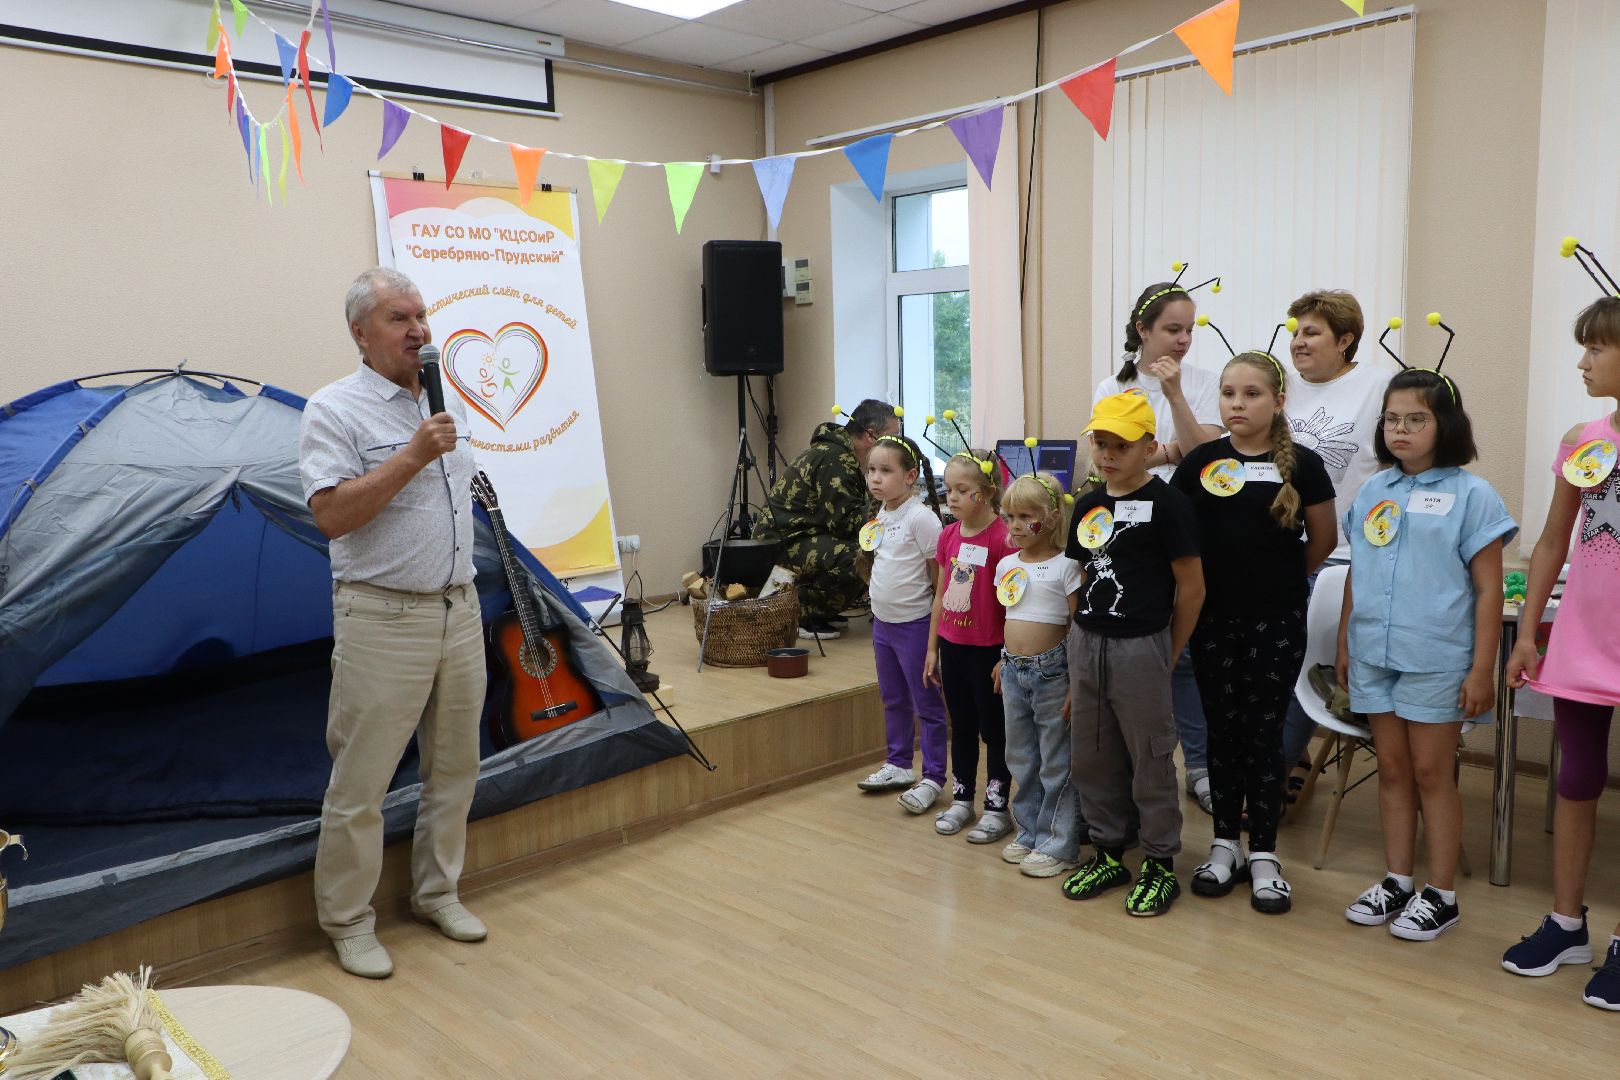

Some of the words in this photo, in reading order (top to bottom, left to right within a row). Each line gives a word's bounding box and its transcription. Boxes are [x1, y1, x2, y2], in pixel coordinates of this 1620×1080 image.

[411, 223, 440, 238] ГАУ
[444, 225, 465, 239] СО
[468, 226, 492, 240] МО
[494, 227, 555, 244] "КЦСОиР
[406, 244, 564, 265] "Серебряно-Прудский"
[426, 284, 490, 317] истический
[492, 285, 520, 298] слёт
[523, 293, 544, 306] для
[545, 303, 579, 330] детей
[470, 437, 532, 453] нностями
[533, 409, 580, 451] развития
